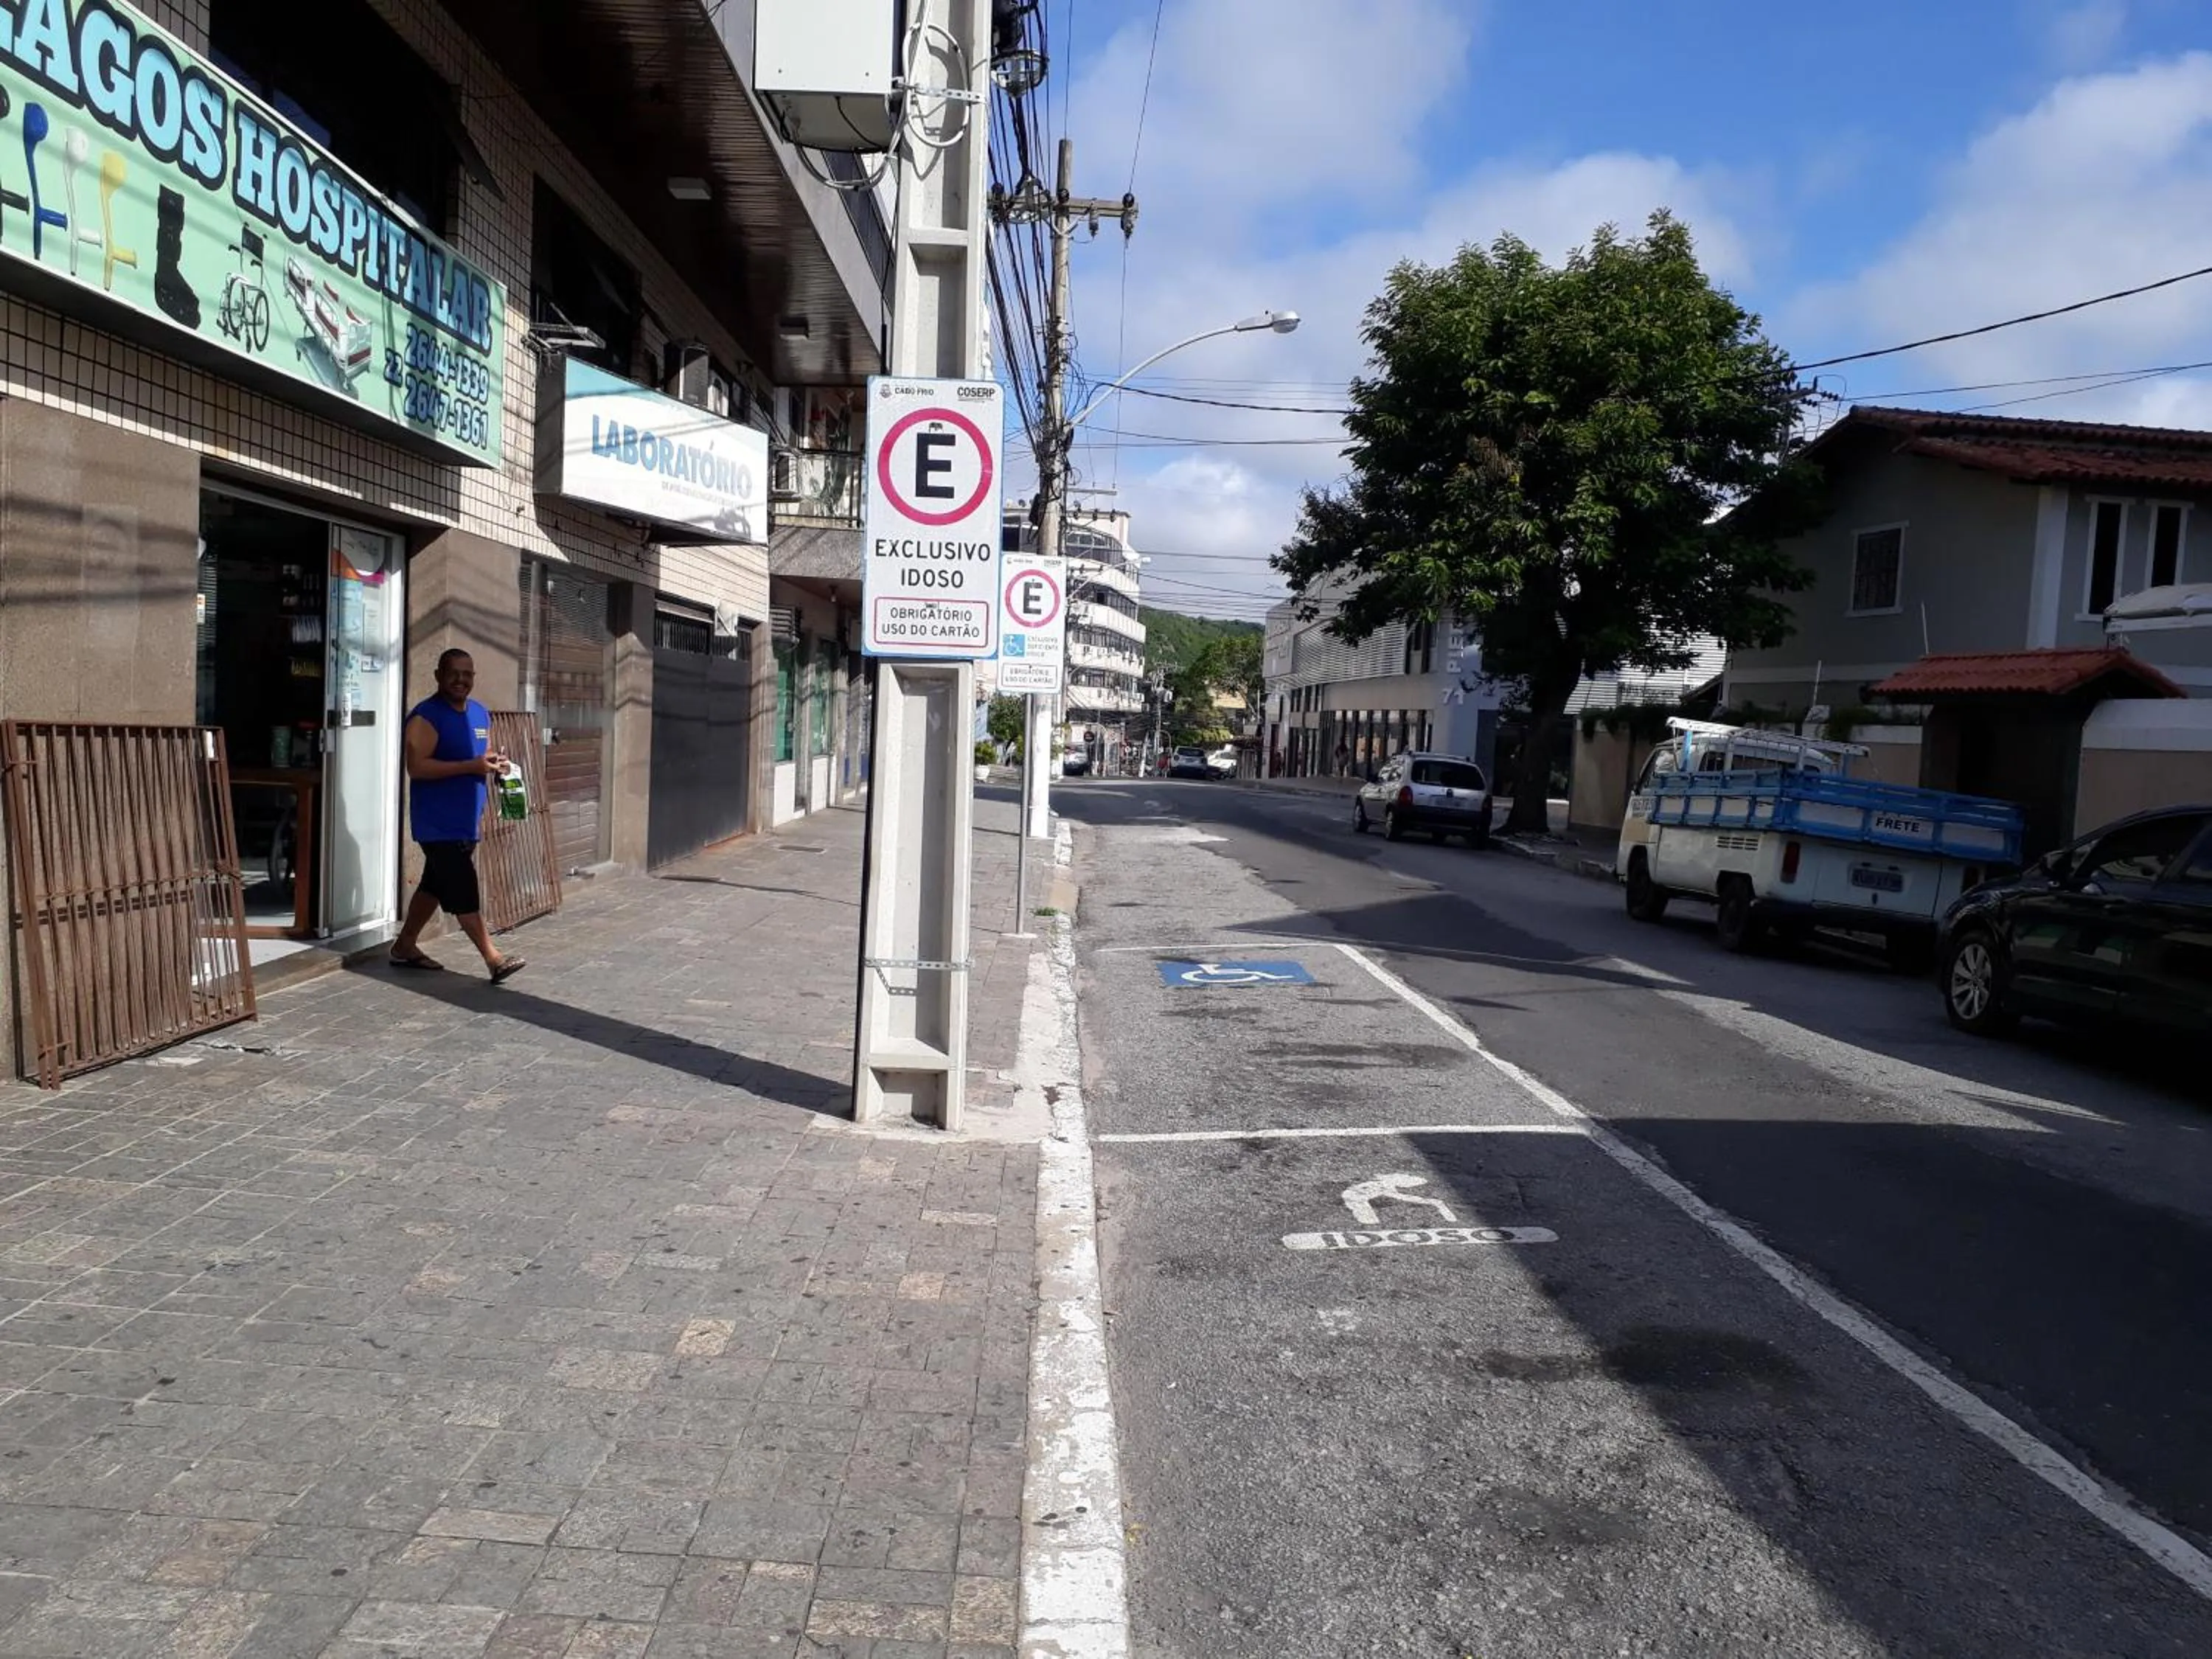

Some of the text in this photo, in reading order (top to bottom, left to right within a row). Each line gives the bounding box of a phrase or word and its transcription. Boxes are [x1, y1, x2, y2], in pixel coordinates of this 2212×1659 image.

[234, 102, 493, 355] HOSPITALAR
[383, 348, 403, 388] 22
[404, 322, 490, 405] 2644-1339
[957, 386, 995, 397] COSERP
[404, 373, 489, 450] 2647-1361
[591, 414, 753, 500] LABORATÓRIO
[915, 432, 956, 499] E
[875, 539, 991, 561] EXCLUSIVO
[901, 568, 964, 588] IDOSO
[1023, 581, 1043, 615] E
[890, 606, 973, 622] OBRIGATÓRIO
[882, 623, 980, 638] USO DO CARTÃO
[1875, 817, 1921, 832] FRETE
[1321, 1229, 1515, 1247] IDOSO
